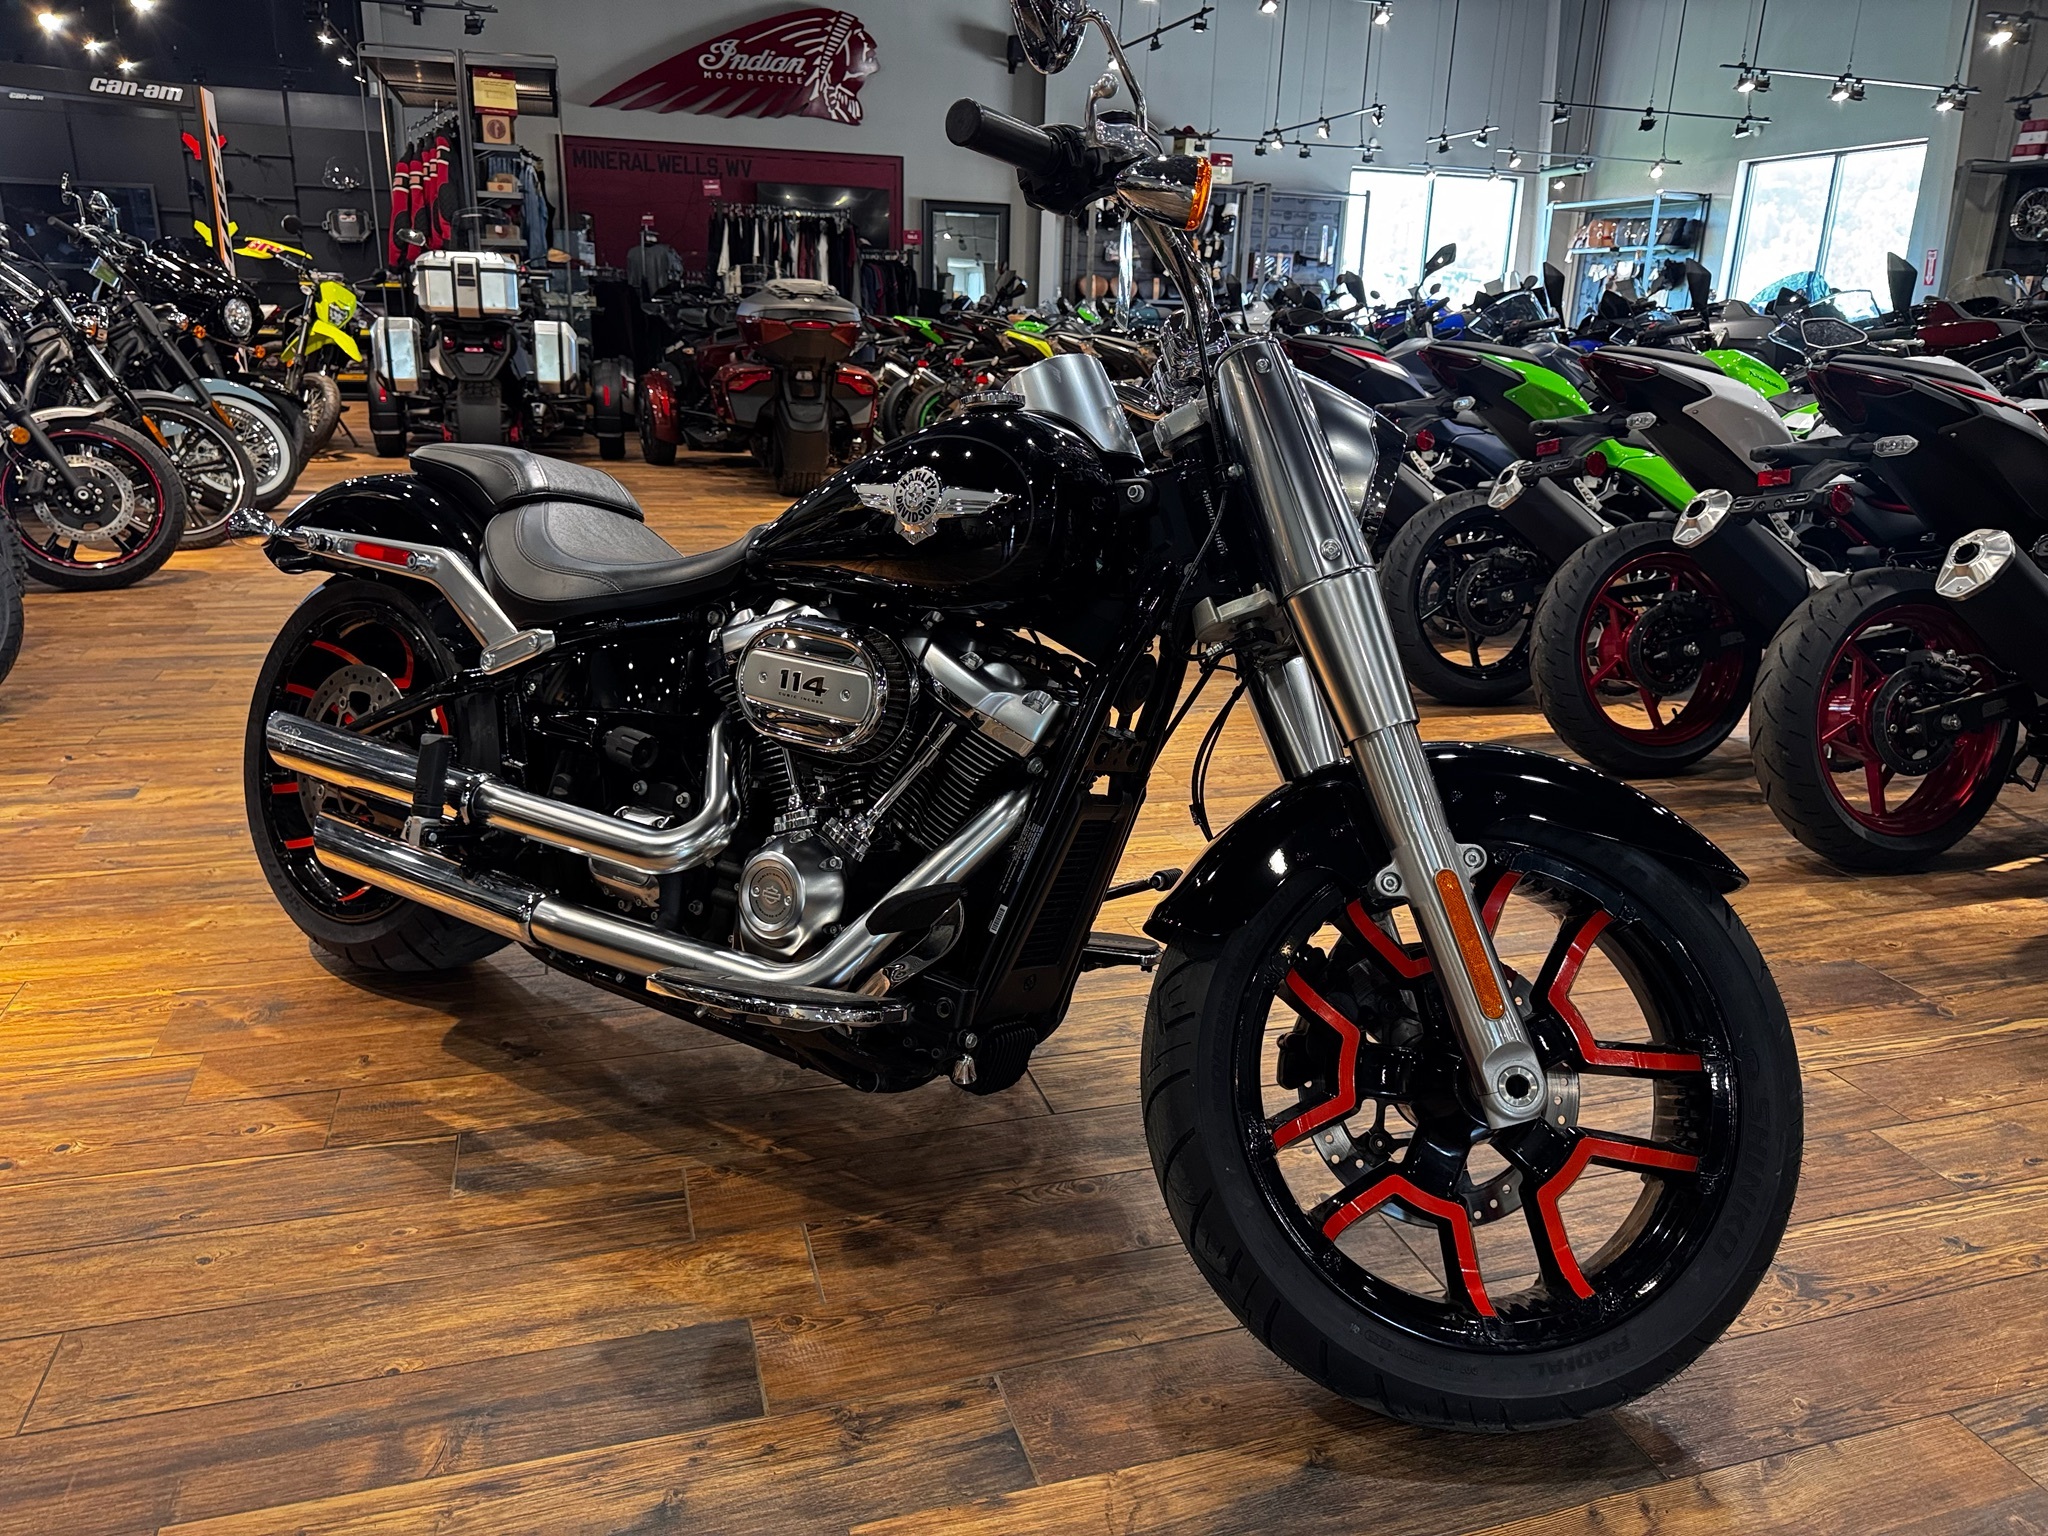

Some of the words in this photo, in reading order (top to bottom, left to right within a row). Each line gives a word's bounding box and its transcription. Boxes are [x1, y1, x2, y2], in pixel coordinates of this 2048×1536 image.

[698, 39, 806, 75] Indian
[89, 77, 184, 102] can-am
[703, 70, 804, 85] MOTORCYCLE
[572, 149, 656, 173] MINERAL
[657, 154, 723, 178] WELLS,
[725, 158, 753, 178] WV
[900, 470, 937, 491] HARLEY
[895, 495, 937, 523] DAVIDSON
[779, 667, 829, 697] 114
[778, 691, 797, 699] CUBIC
[800, 696, 824, 705] INCHES
[1528, 1333, 1631, 1376] RADIAL
